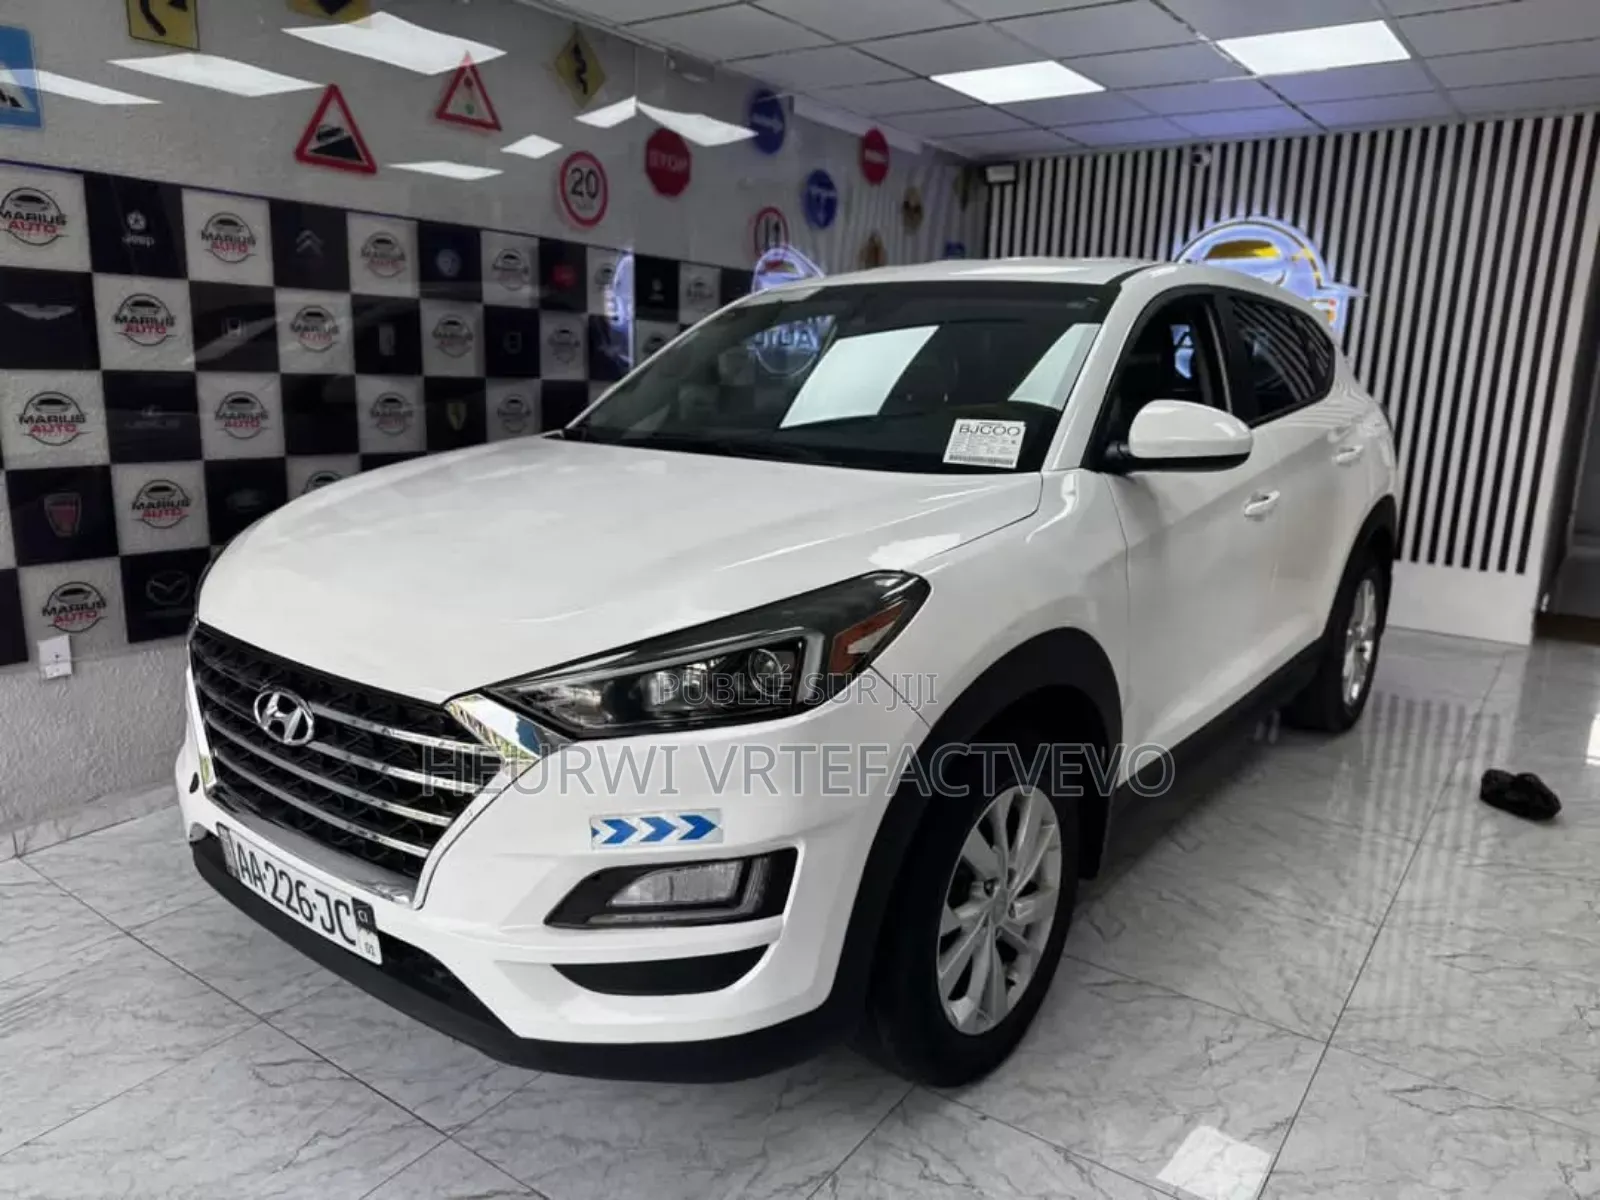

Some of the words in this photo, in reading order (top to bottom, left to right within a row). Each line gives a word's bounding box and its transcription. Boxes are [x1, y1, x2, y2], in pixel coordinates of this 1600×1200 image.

[570, 167, 600, 199] 20
[9, 219, 57, 234] AUTO
[19, 413, 86, 425] MARIUS
[31, 423, 78, 434] AUTO
[131, 499, 191, 510] MARIUS
[42, 599, 106, 616] MARIUS
